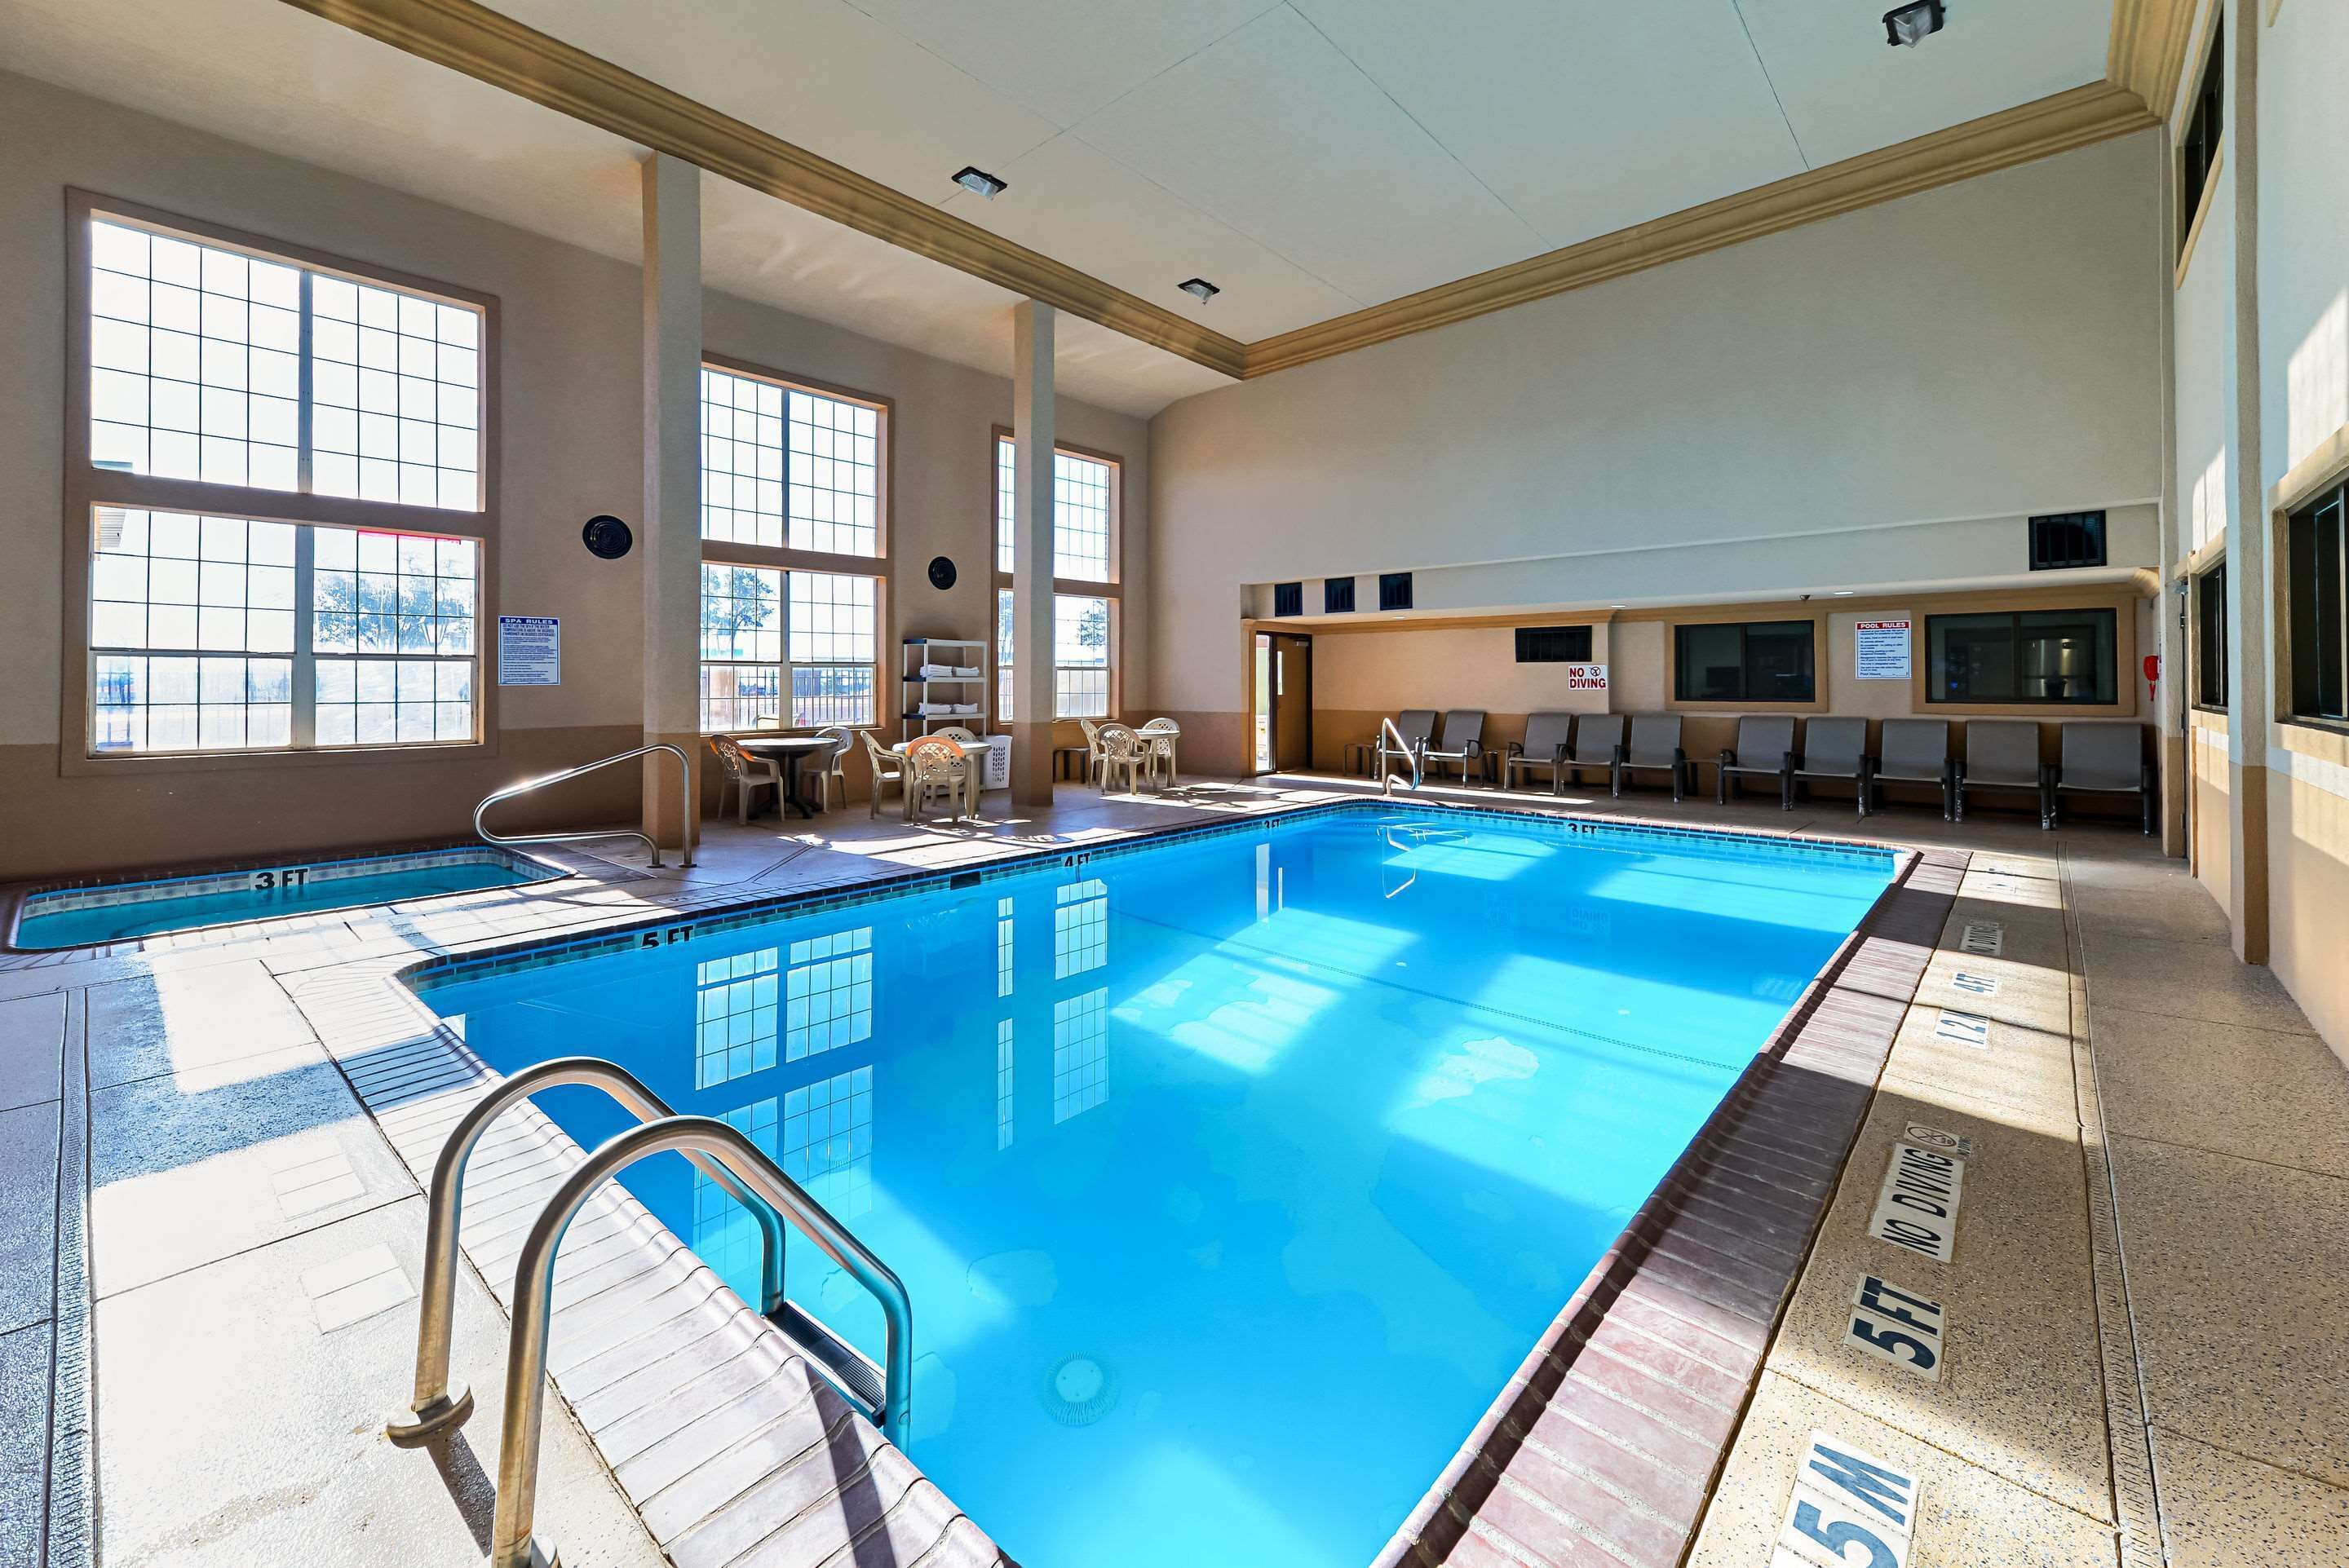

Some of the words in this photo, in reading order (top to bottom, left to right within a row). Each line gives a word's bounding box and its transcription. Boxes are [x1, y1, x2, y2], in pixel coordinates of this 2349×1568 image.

[1569, 667, 1585, 678] NO
[1569, 678, 1606, 688] DIVING
[1582, 824, 1597, 835] FT
[1064, 855, 1073, 868] 4
[1077, 852, 1090, 865] FT
[254, 872, 275, 890] 3
[282, 868, 308, 887] FT
[640, 932, 660, 950] 5
[667, 925, 694, 945] FT
[1891, 1148, 1954, 1218] DIVING
[1881, 1218, 1941, 1257] NO
[1852, 1317, 1936, 1371] 5
